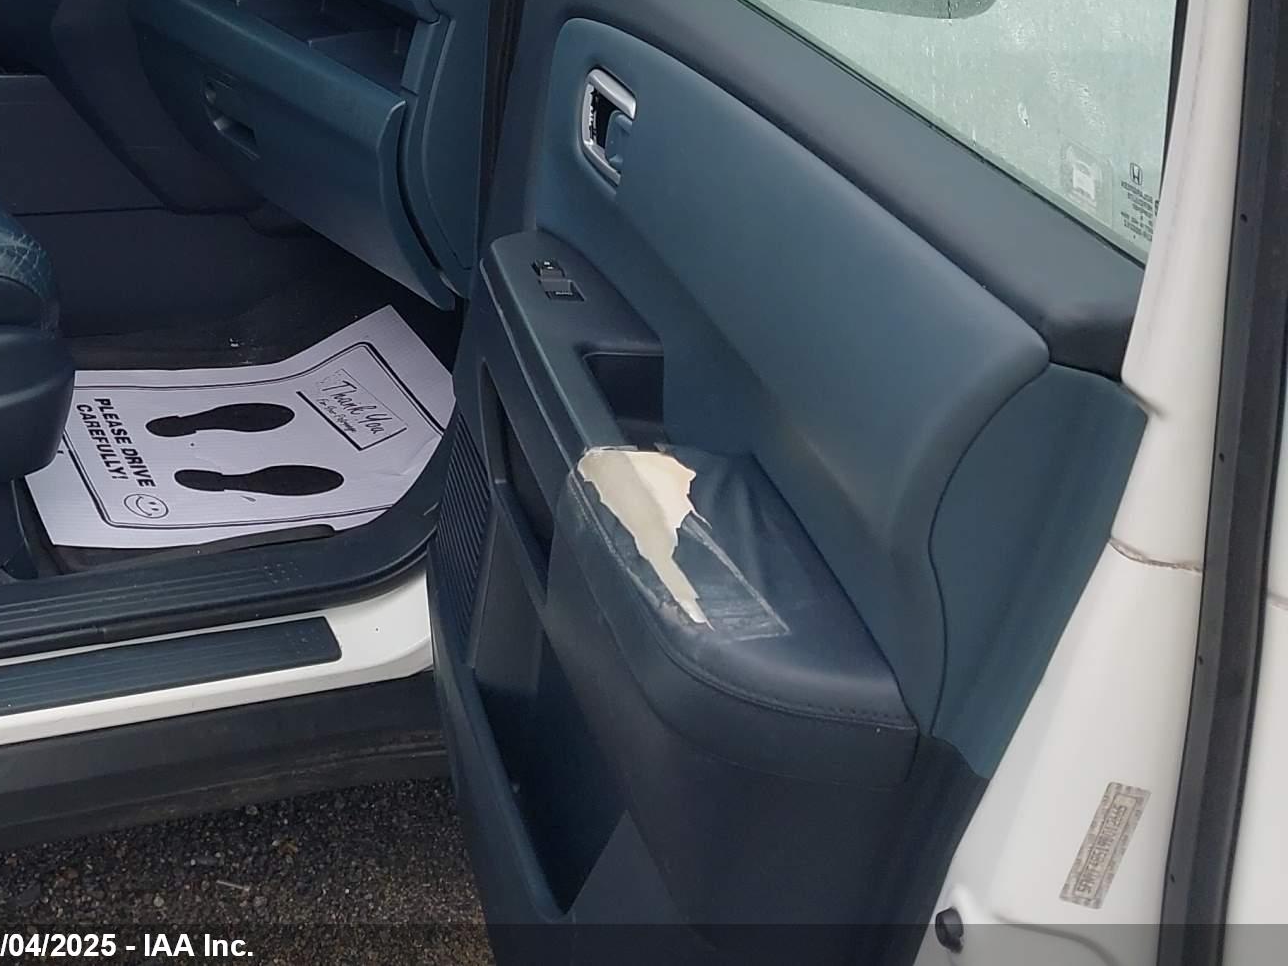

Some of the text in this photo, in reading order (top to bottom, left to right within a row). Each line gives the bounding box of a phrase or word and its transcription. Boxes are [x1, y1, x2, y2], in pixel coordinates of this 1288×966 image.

[76, 404, 129, 479] CAREFULLY!
[94, 398, 156, 487] PLEASE DRIVE
[322, 380, 377, 414] Thank
[358, 413, 392, 435] You
